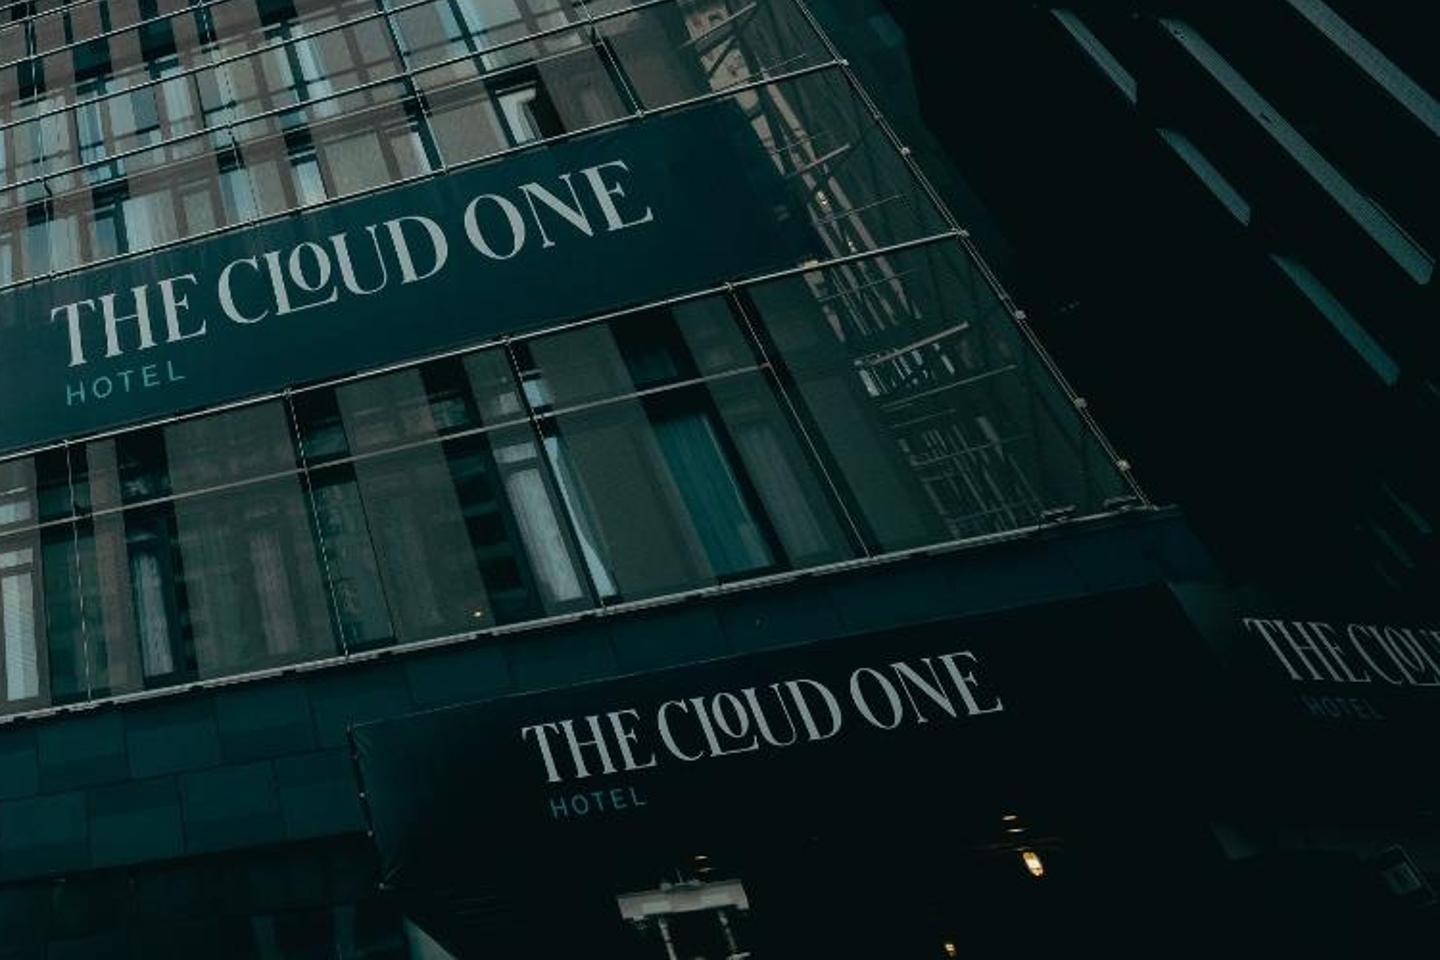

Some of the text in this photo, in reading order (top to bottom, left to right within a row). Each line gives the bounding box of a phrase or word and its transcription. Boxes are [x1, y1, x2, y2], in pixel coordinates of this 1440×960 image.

[51, 160, 654, 368] THE CLOUD ONE
[66, 359, 186, 406] HOTEL
[1242, 617, 1372, 682] THE
[521, 650, 1005, 783] THE CLOUD ONE
[550, 787, 649, 819] HOTEL
